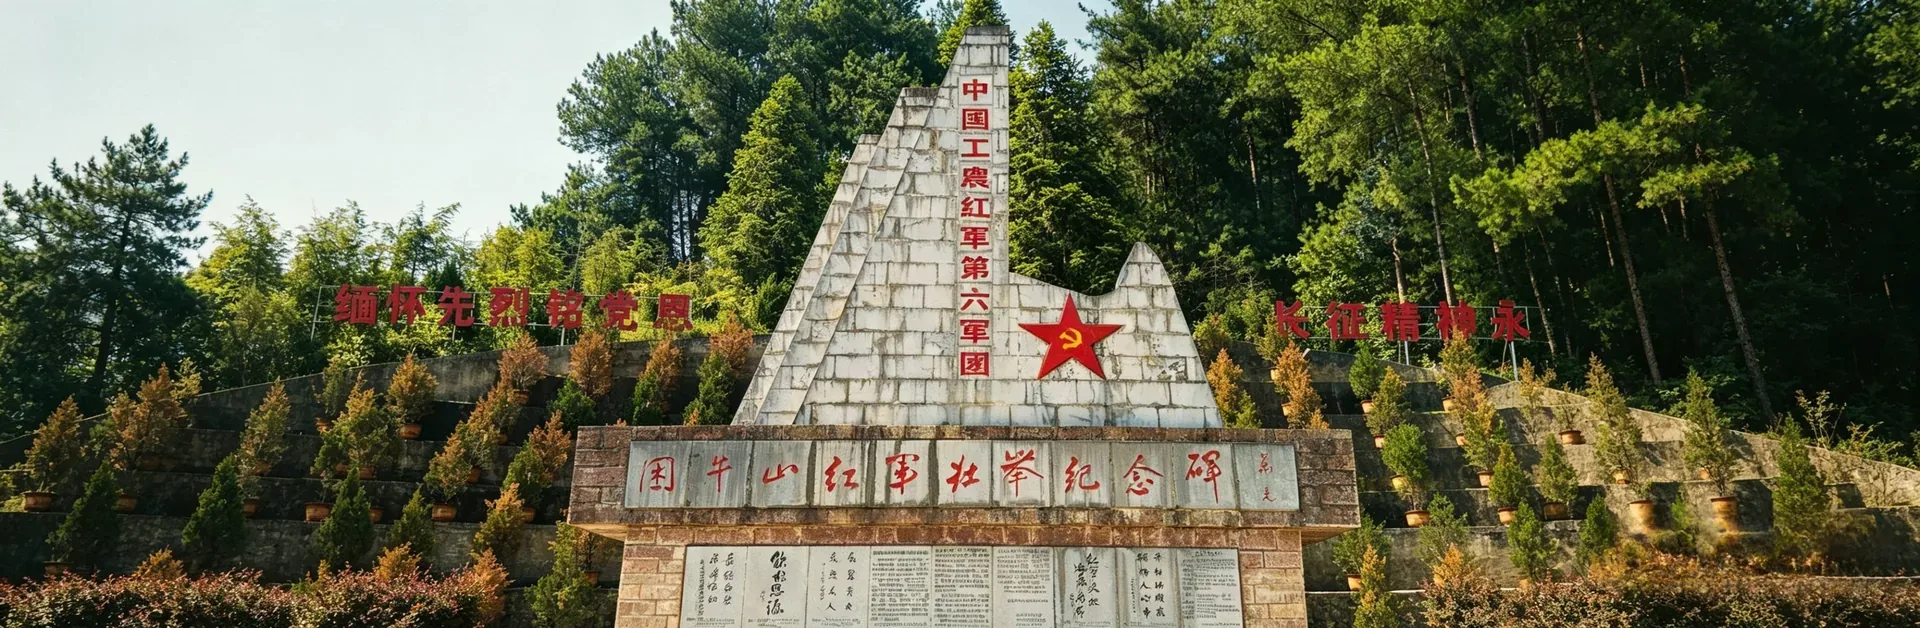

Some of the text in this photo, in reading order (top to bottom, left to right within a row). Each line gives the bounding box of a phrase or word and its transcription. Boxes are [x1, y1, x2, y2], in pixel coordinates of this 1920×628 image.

[333, 284, 693, 331] 缅怀先烈铭党恩
